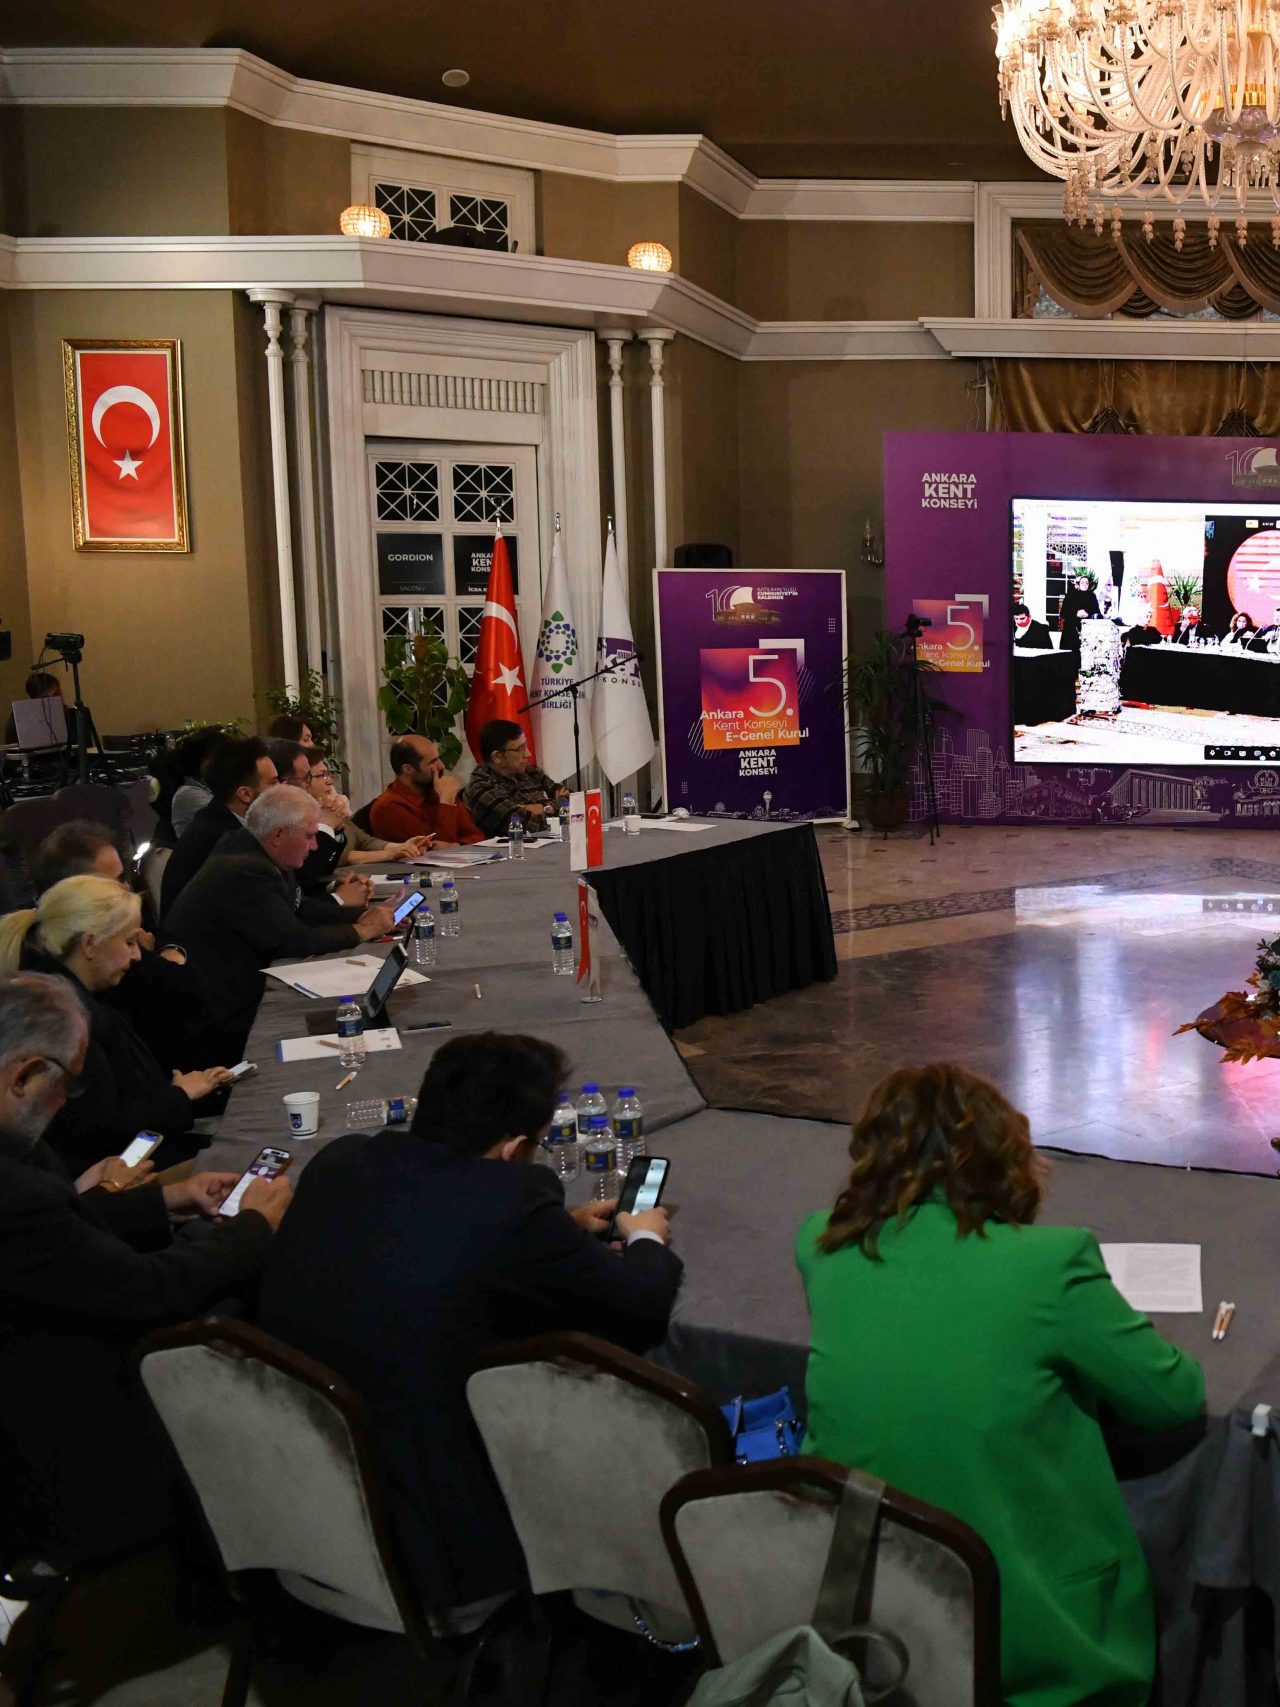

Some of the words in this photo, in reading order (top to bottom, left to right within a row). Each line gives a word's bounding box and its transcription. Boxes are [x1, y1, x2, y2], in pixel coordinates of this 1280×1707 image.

[922, 473, 977, 483] ANKARA
[924, 483, 975, 498] KENT
[472, 559, 492, 567] KEN
[946, 605, 979, 651] 5.
[929, 659, 964, 667] -Genel
[967, 660, 990, 668] Kurul
[748, 655, 794, 717] 5.
[700, 709, 744, 720] Ankara
[713, 721, 740, 731] Kent
[744, 718, 788, 730] Konseyi
[726, 730, 774, 742] E-Genel
[778, 727, 809, 739] Kurul
[738, 749, 776, 758] ANKARA
[740, 757, 775, 769] KENT
